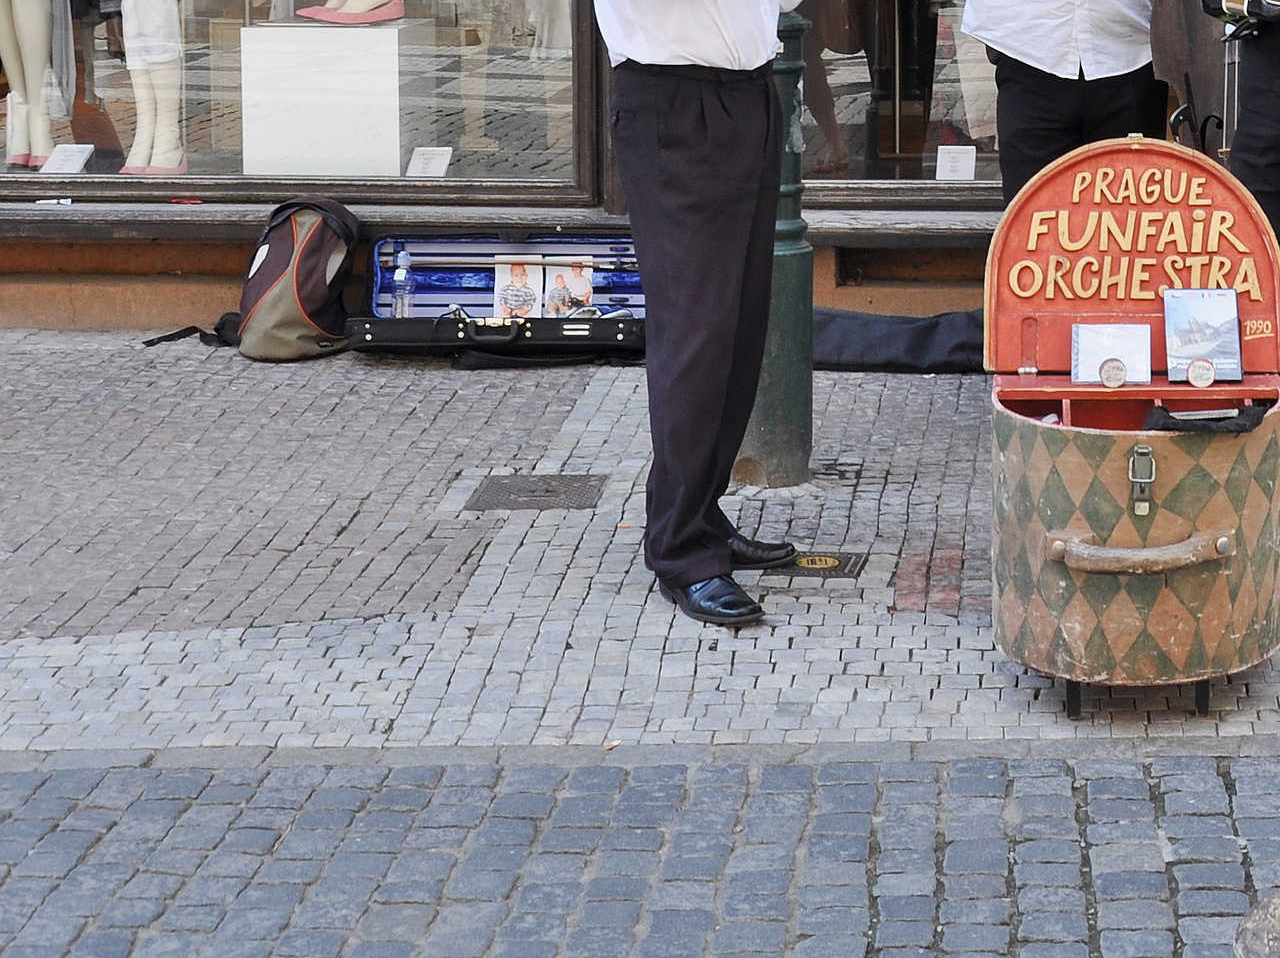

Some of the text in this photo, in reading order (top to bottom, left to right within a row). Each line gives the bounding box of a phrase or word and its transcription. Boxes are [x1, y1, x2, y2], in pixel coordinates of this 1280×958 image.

[1072, 167, 1212, 206] PRAGUE
[1008, 254, 1264, 302] ORCHESTRA
[1244, 319, 1272, 336] 1990
